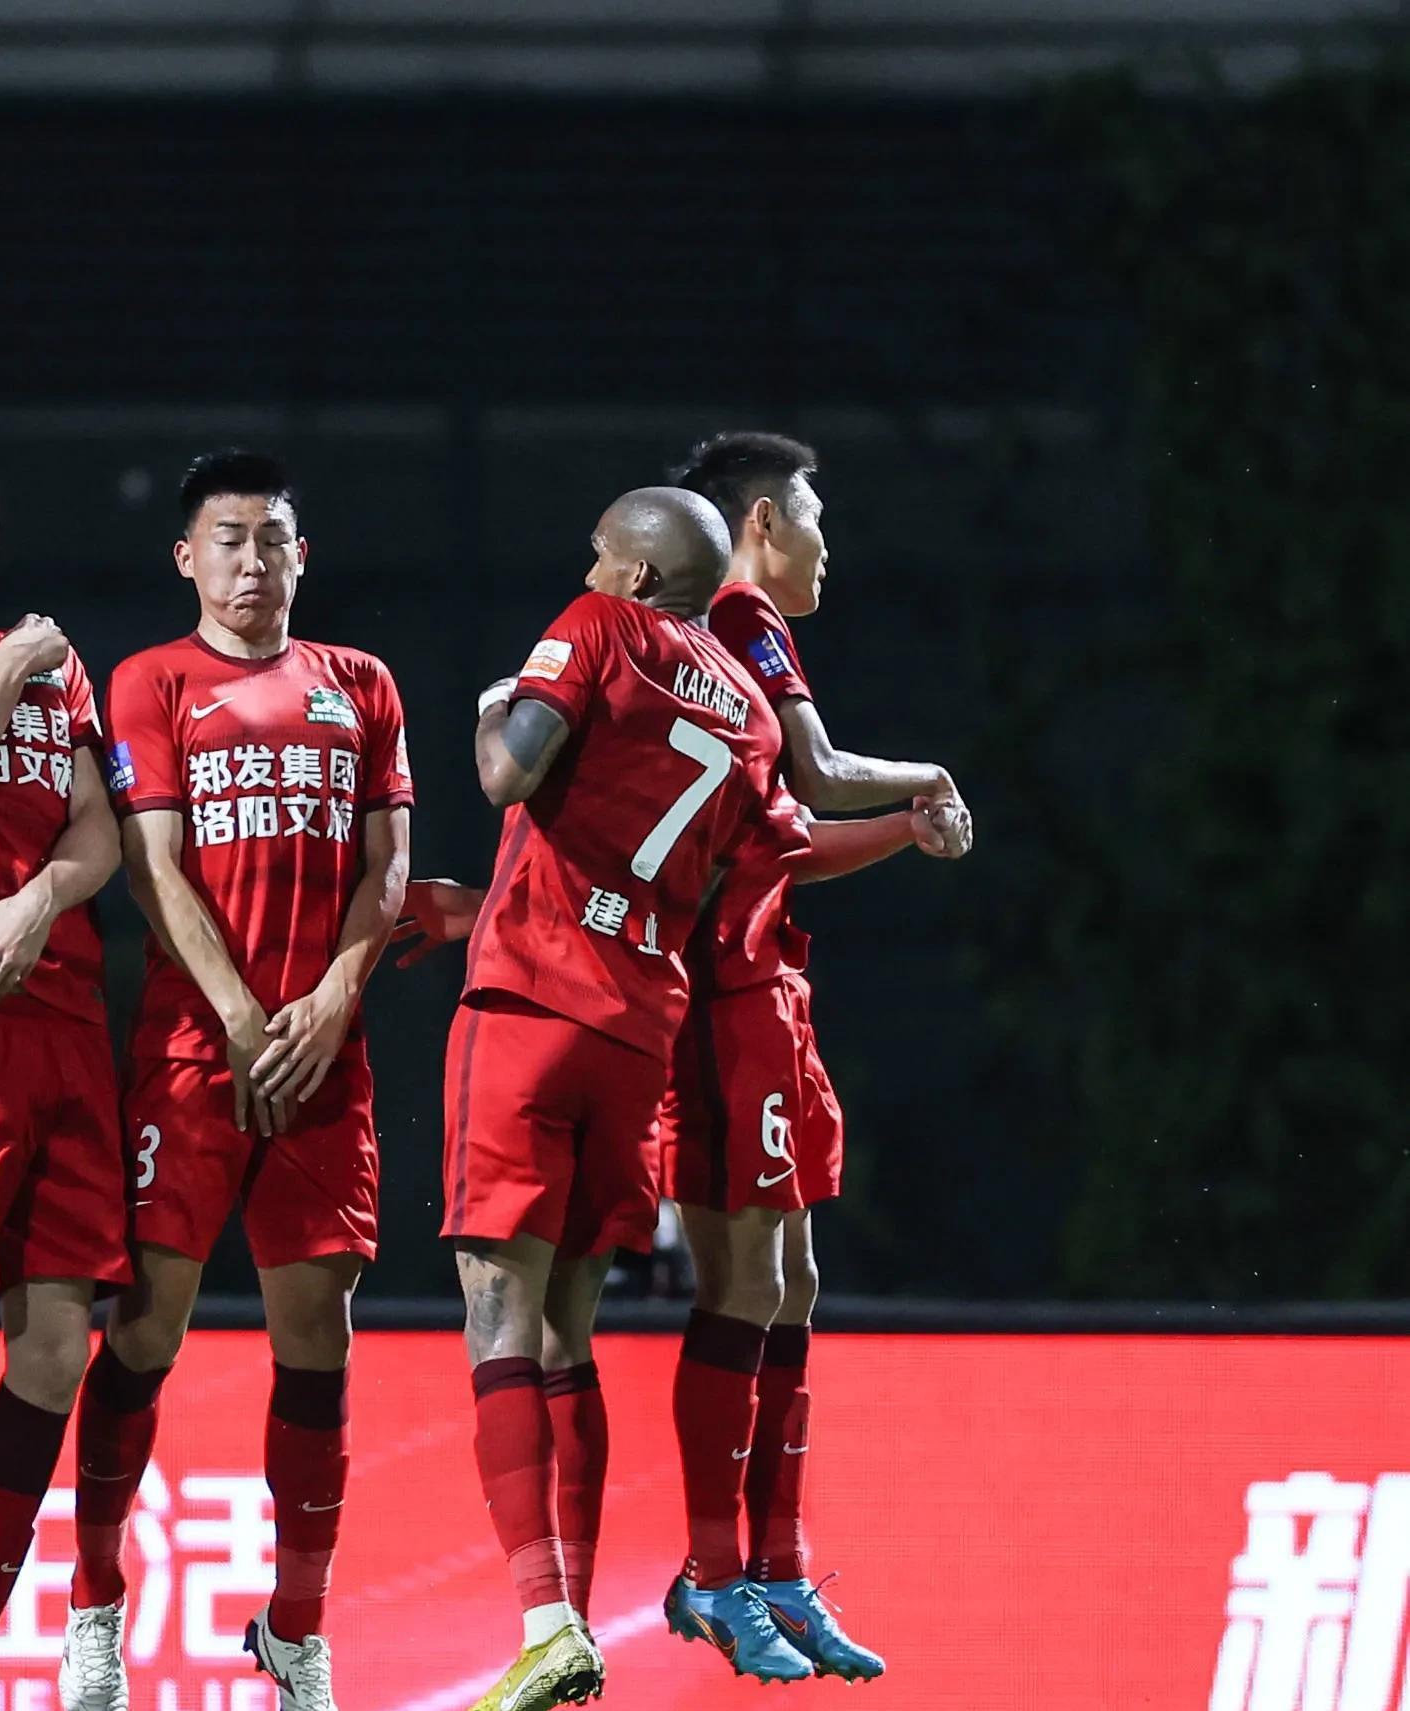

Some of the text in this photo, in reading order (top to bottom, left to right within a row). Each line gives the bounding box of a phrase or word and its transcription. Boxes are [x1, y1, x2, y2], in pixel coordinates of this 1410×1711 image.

[673, 662, 749, 732] KARANGA
[188, 744, 360, 799] 郑发集团
[631, 716, 732, 882] 7
[192, 793, 354, 848] 洛阳文旅
[762, 1092, 788, 1158] 6
